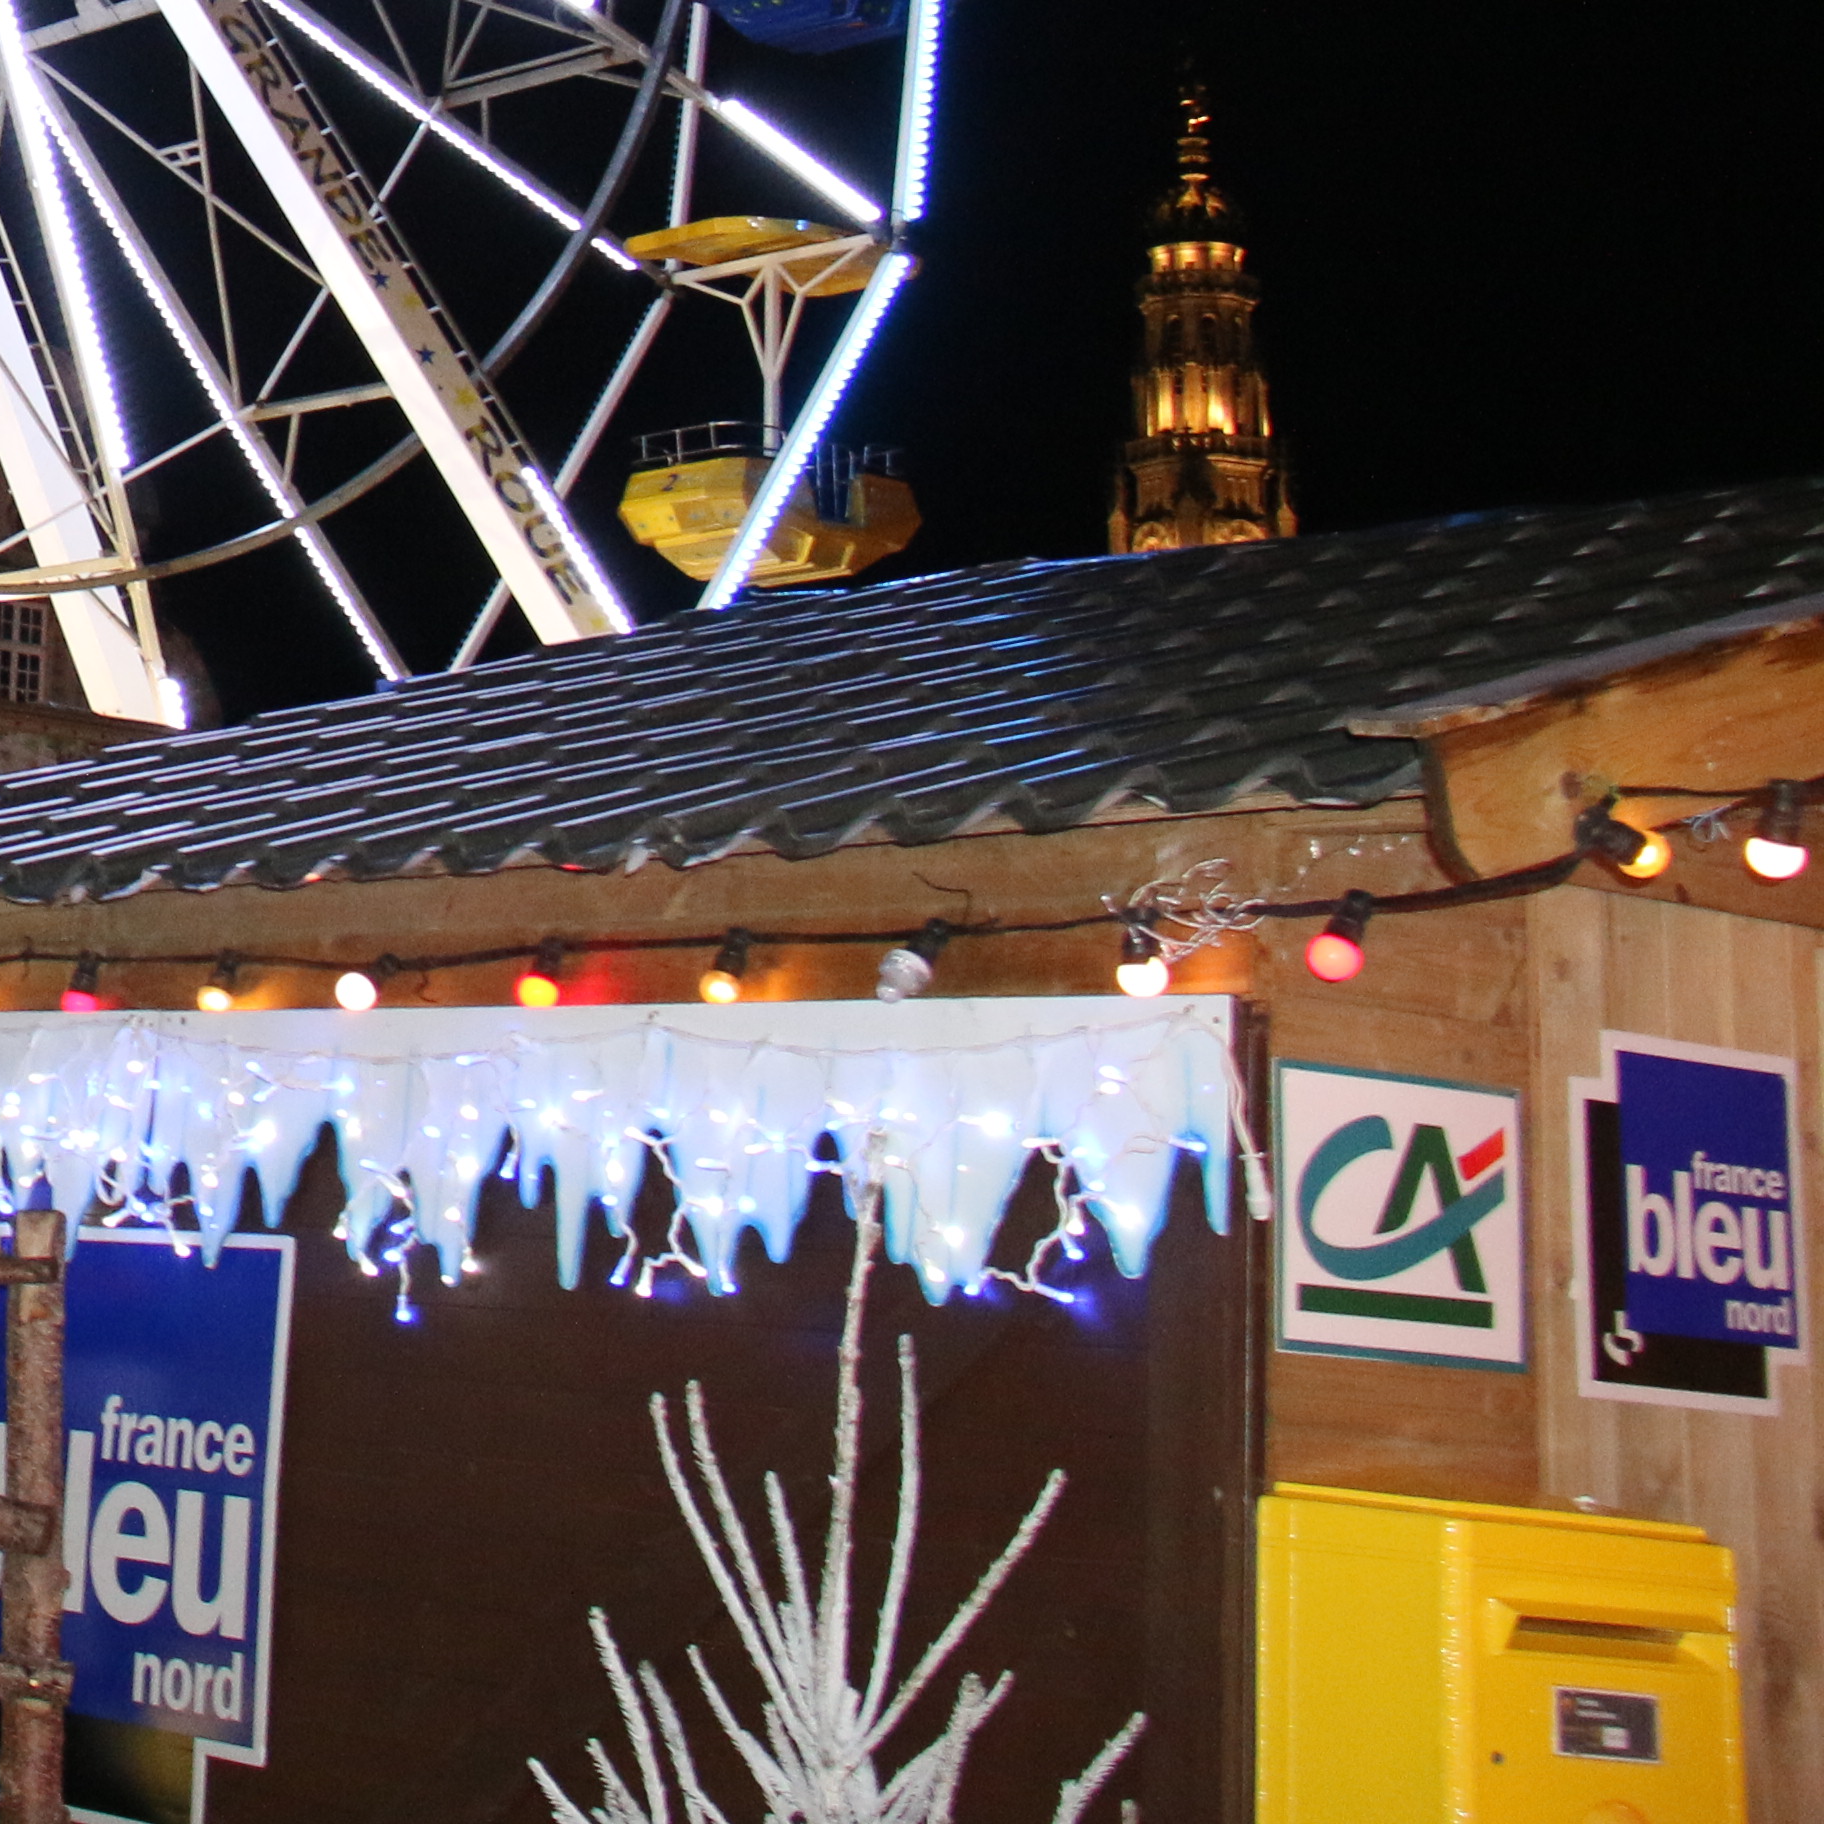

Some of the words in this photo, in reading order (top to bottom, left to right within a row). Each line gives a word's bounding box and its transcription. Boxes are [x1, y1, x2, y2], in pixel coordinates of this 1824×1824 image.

[219, 15, 392, 270] GRANDE
[465, 416, 592, 606] ROUE
[1296, 1114, 1505, 1294] CA
[1691, 1150, 1786, 1200] france
[1625, 1163, 1791, 1291] bleu
[1725, 1297, 1793, 1336] nord
[100, 1394, 256, 1476] france
[131, 1650, 244, 1723] nord
